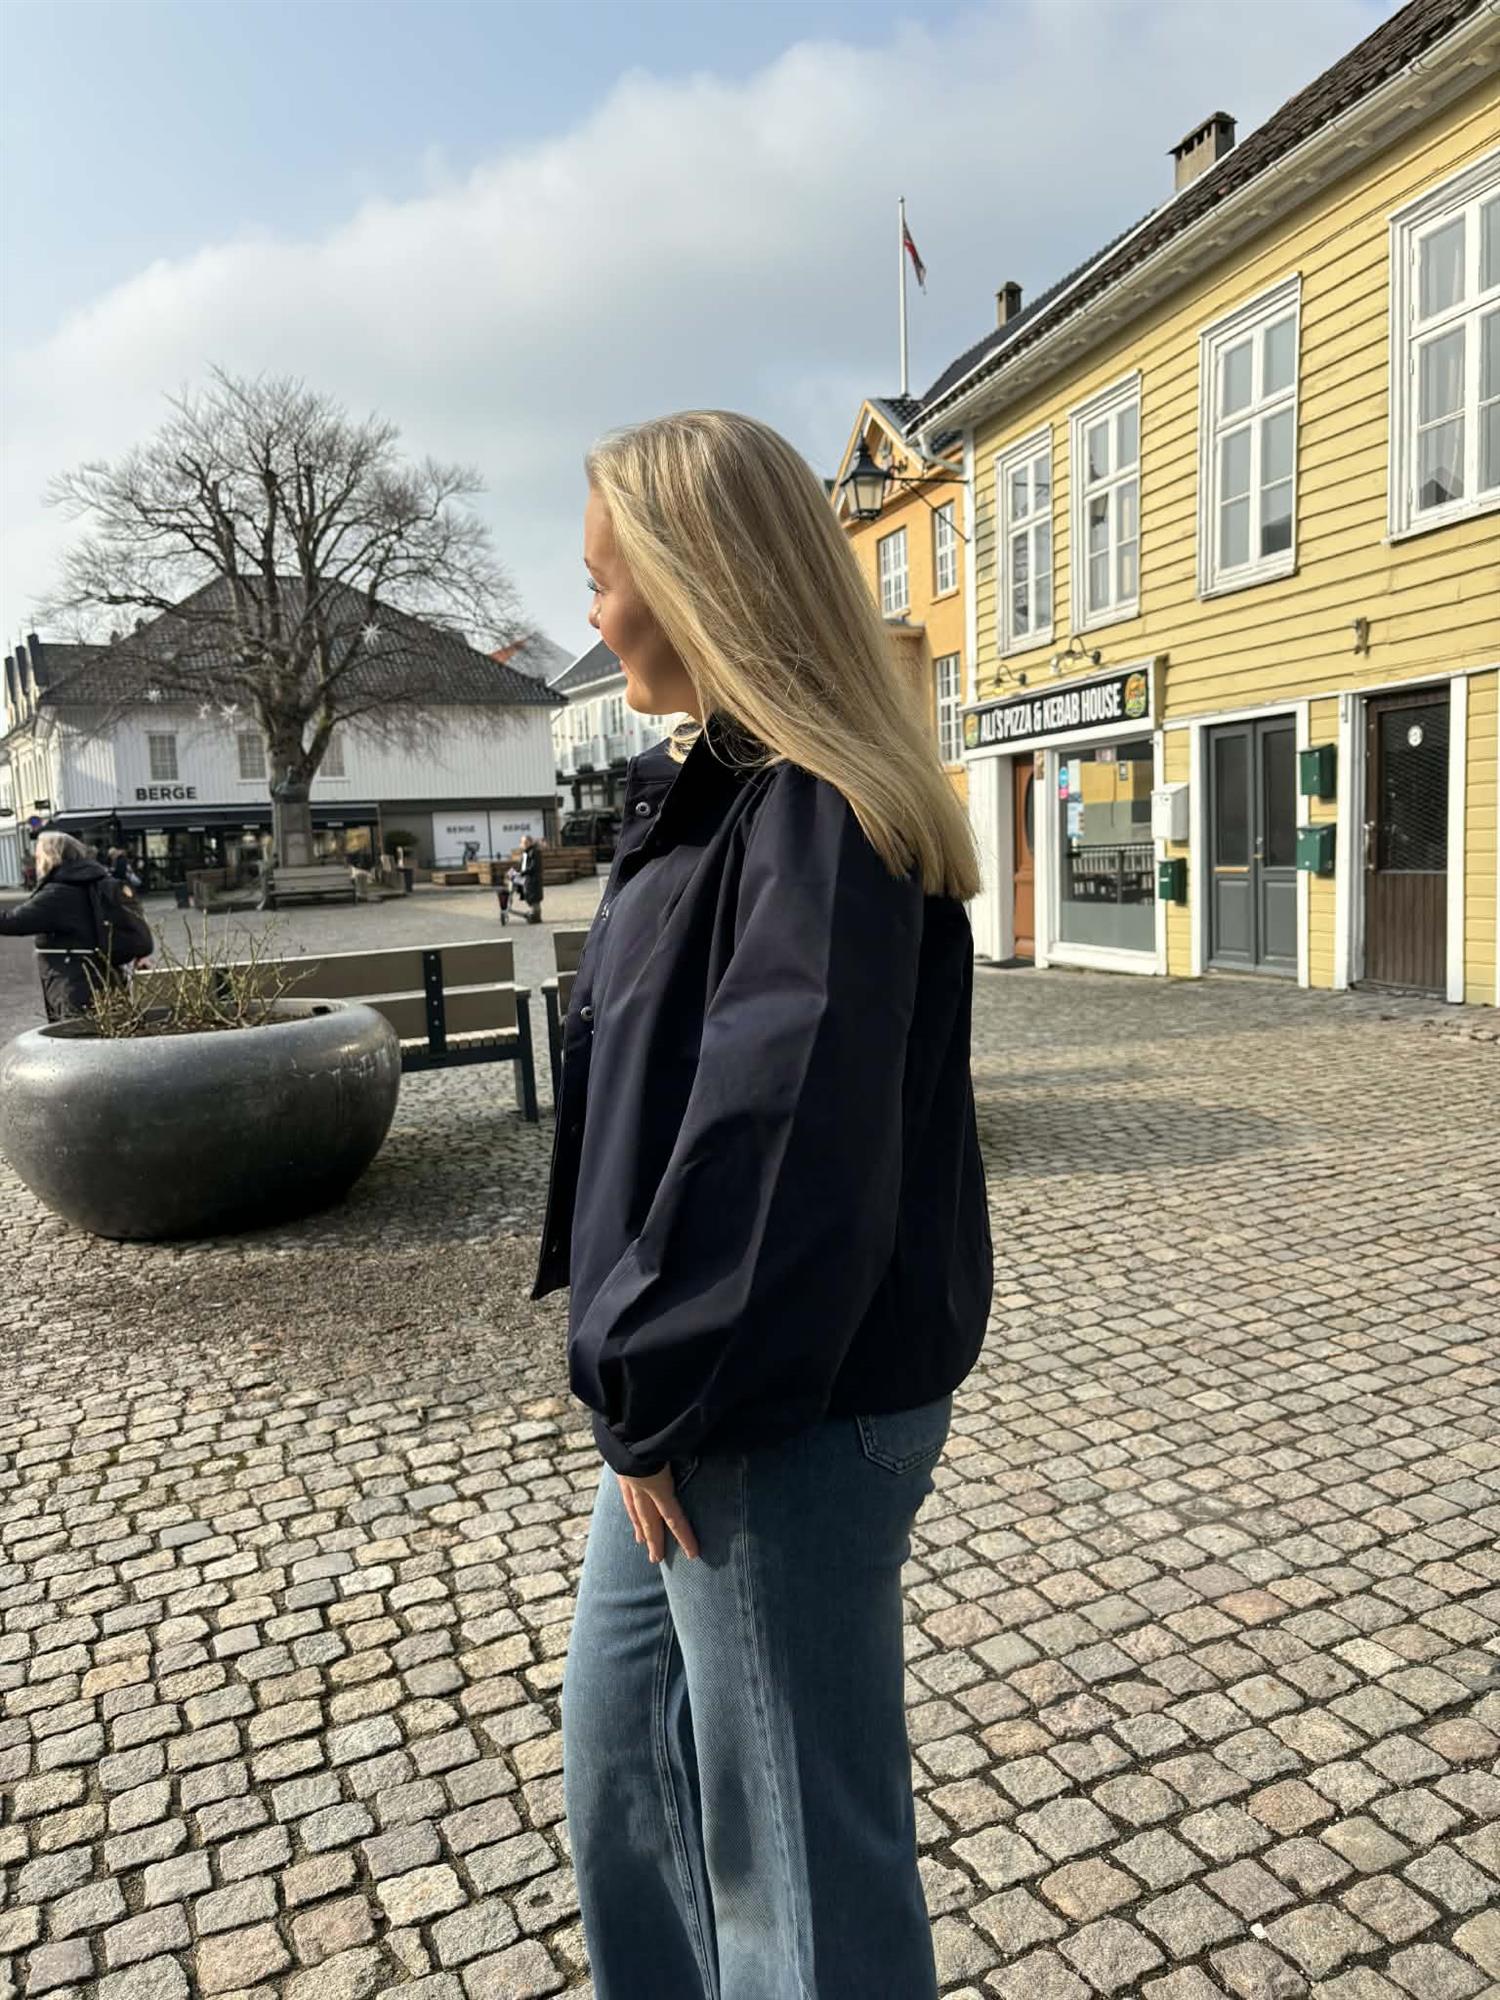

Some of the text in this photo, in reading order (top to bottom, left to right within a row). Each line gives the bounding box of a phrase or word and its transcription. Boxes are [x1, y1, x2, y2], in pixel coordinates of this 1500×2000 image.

[981, 682, 1122, 743] ALI'S PIZZA & KEBAB HOUSE
[135, 786, 197, 801] BERGE
